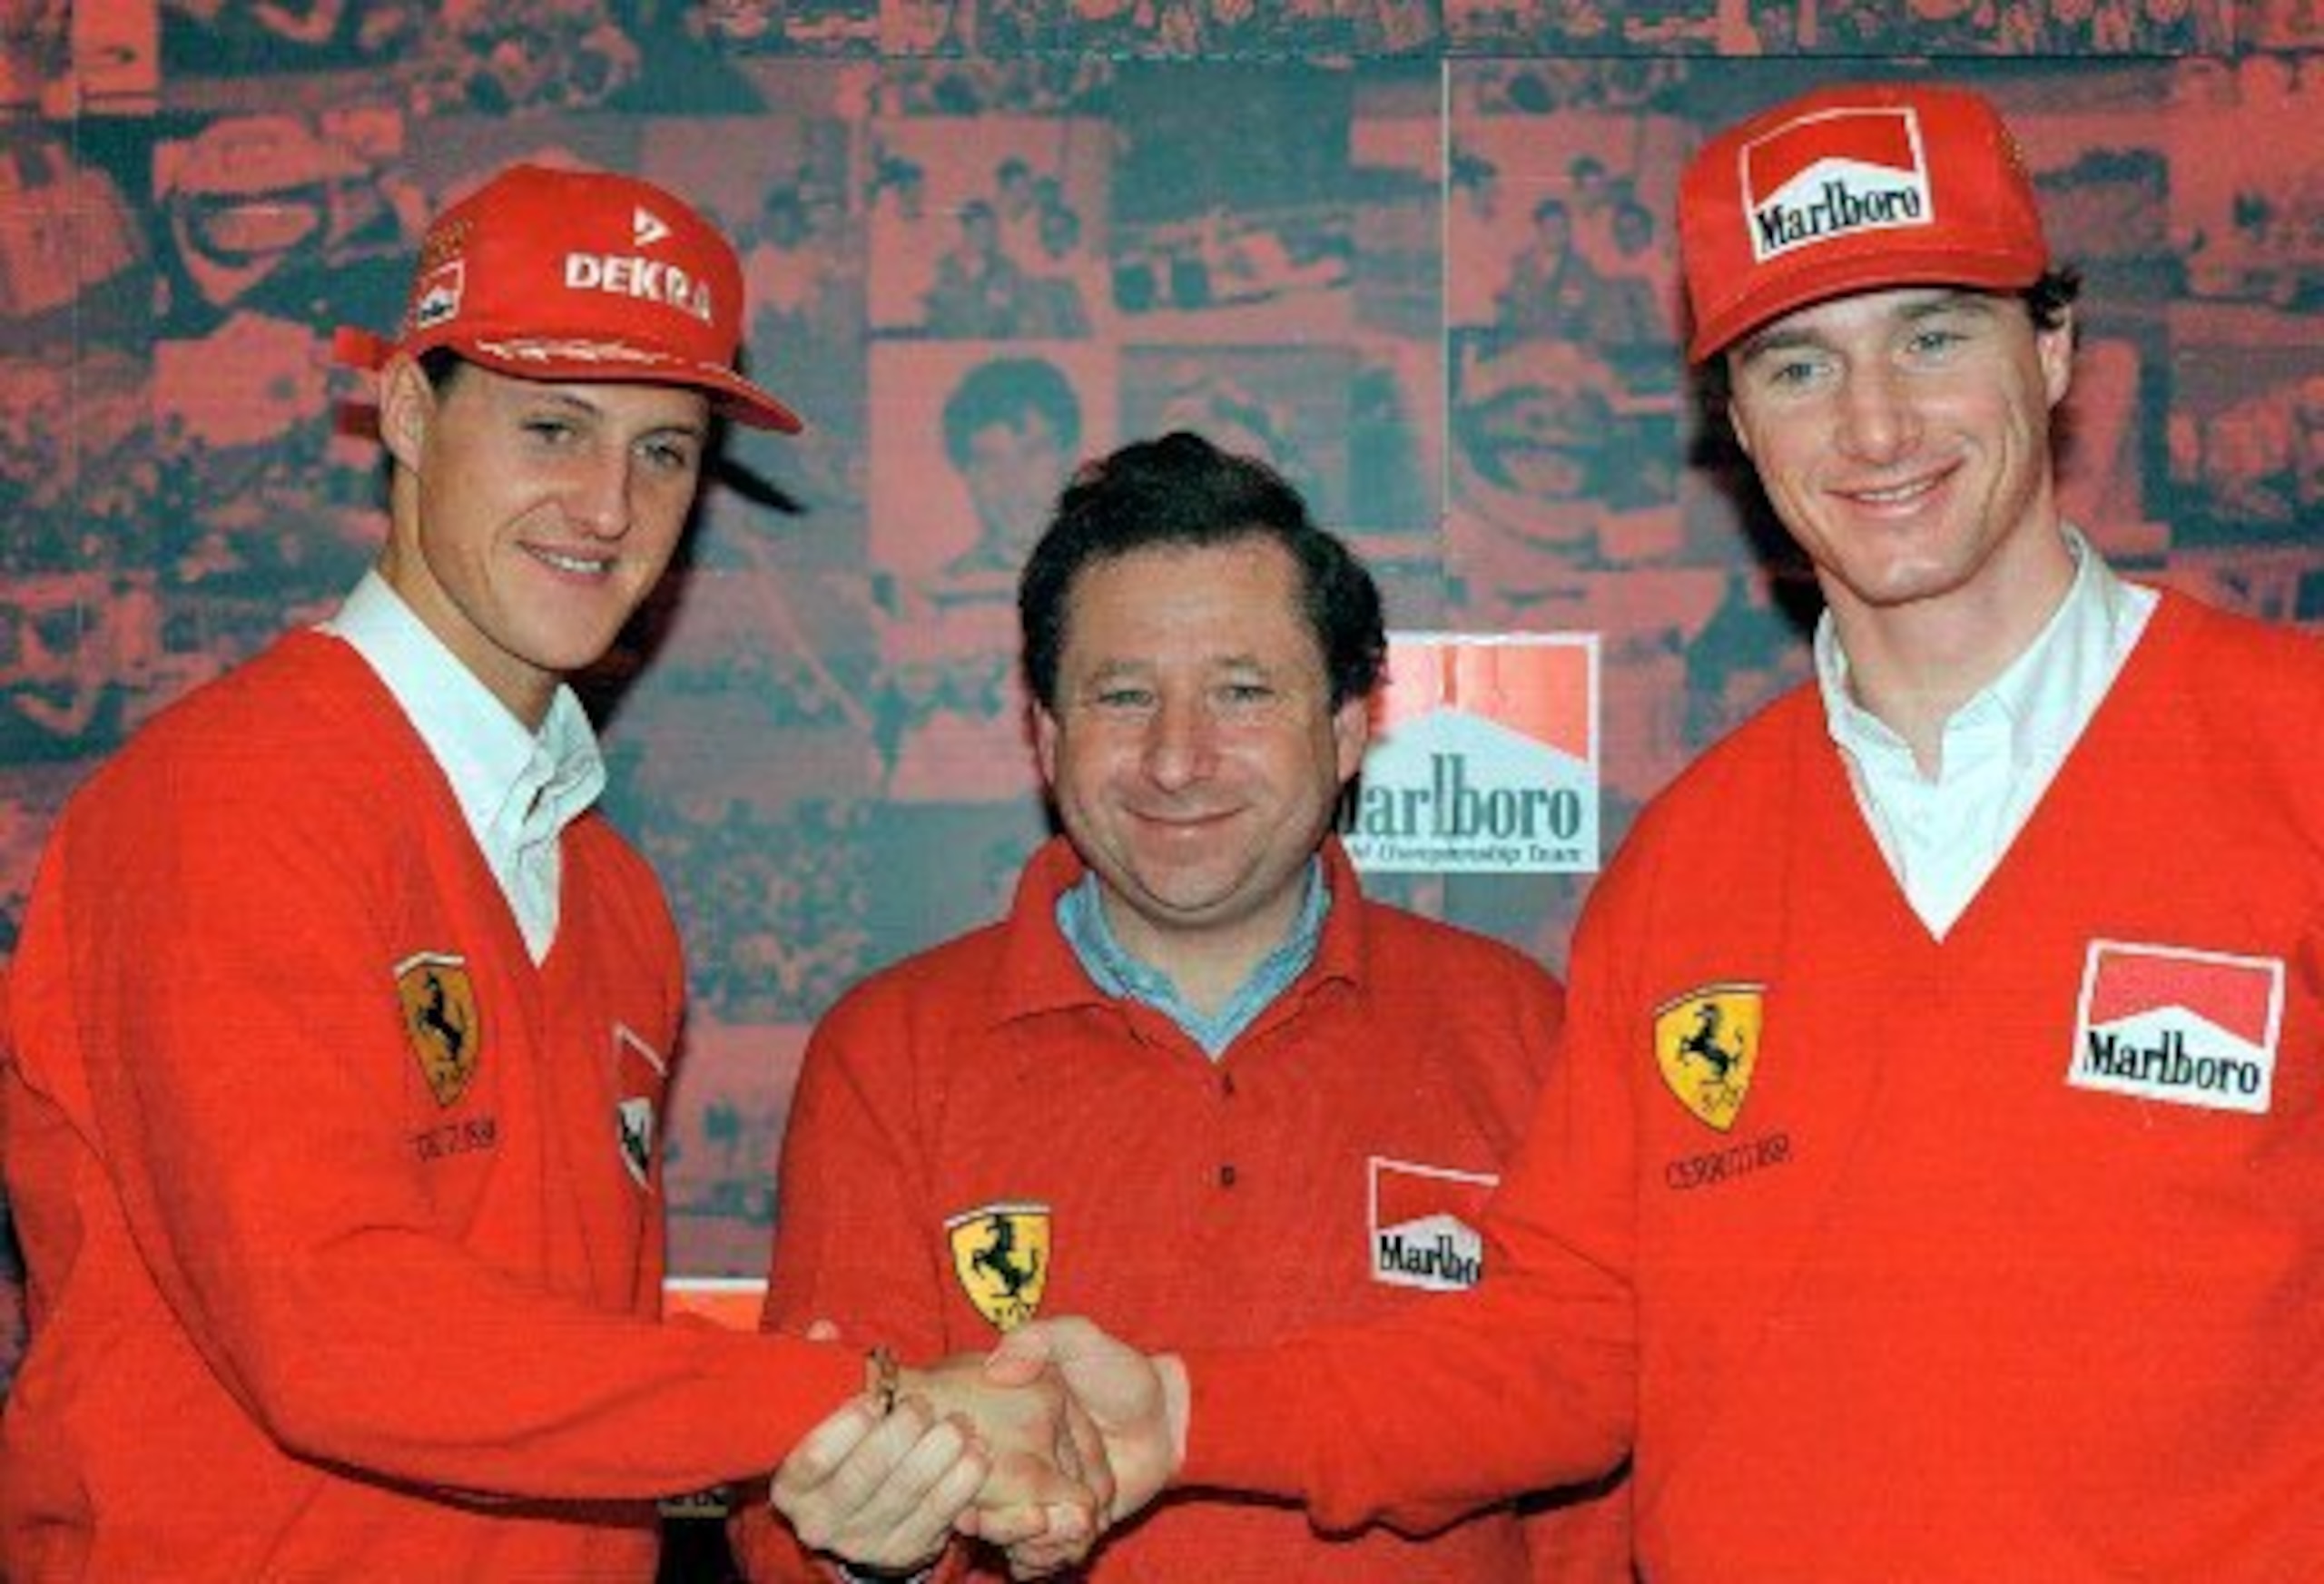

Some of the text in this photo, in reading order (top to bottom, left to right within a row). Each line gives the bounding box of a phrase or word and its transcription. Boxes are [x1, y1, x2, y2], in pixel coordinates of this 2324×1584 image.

[1757, 179, 1921, 253] Marlboro
[565, 252, 714, 327] DEKRA
[1342, 753, 1581, 840] arlboro
[2083, 1029, 2260, 1096] Marlboro
[1379, 1235, 1482, 1285] Marlbo
